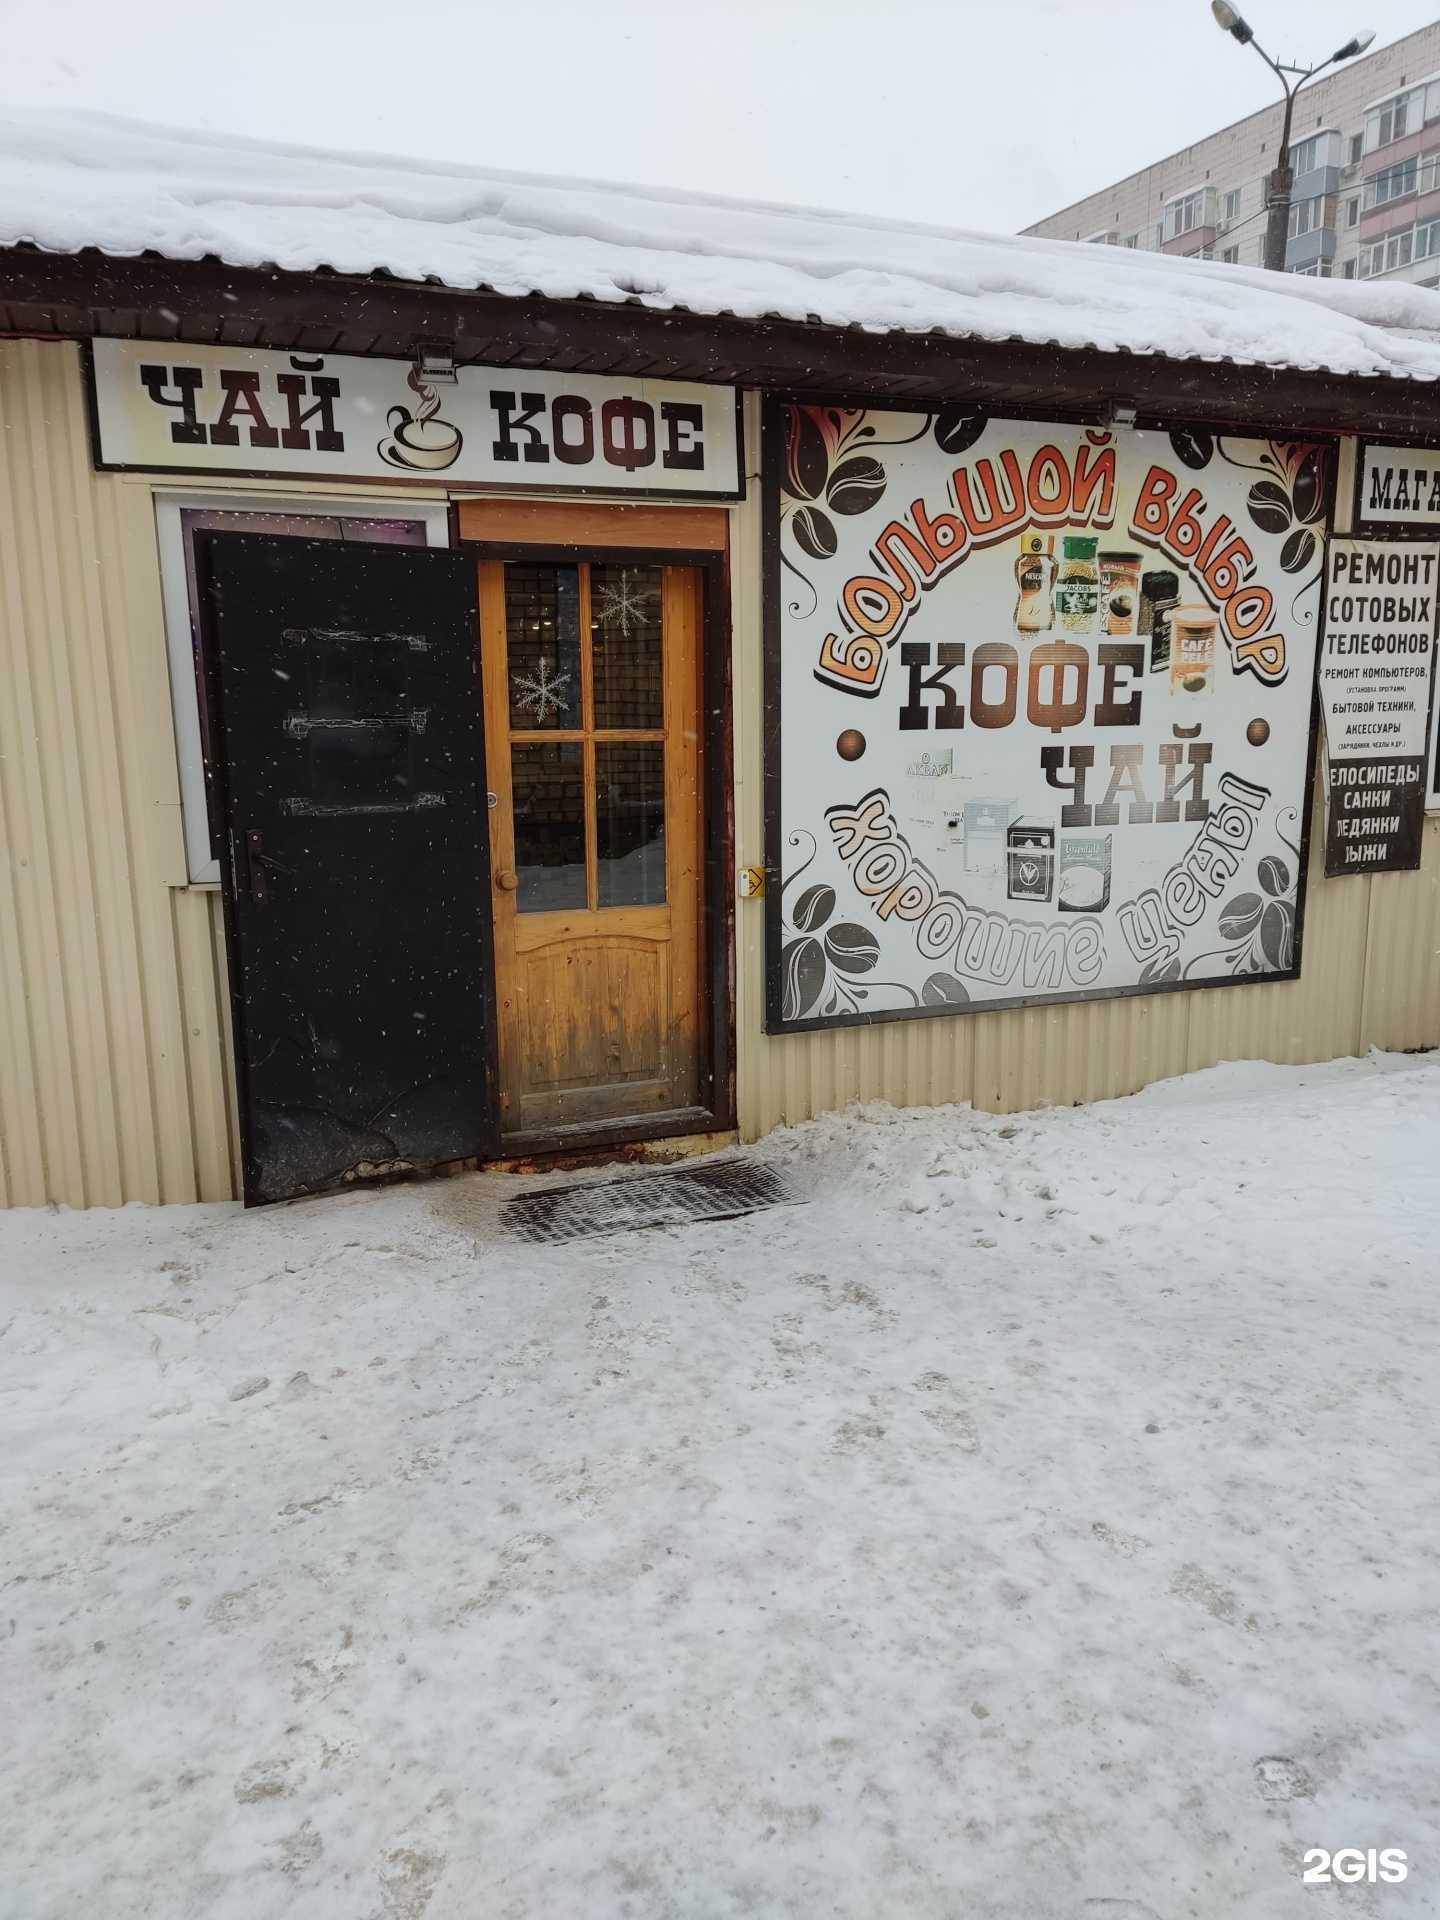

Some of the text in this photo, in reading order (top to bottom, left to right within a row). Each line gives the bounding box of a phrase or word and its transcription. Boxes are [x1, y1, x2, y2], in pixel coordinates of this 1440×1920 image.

[140, 356, 705, 472] ЧАЙ КОФЕ
[814, 429, 1289, 697] БОЛЬШОЙ ВЫБОР
[1332, 552, 1436, 585] РЕМОНТ
[1066, 584, 1092, 592] JACOBS
[1330, 596, 1431, 623] СОТОВЫХ
[1327, 633, 1429, 655] ТЕЛЕФОНОВ
[1325, 668, 1360, 679] РЕМОНТ
[899, 639, 1145, 734] КОФЕ
[1332, 701, 1375, 713] БЫТОВОЙ
[1345, 722, 1401, 735] АКСЕССУАРЫ
[1041, 723, 1213, 828] ЧАЙ
[1343, 789, 1392, 810] САНКИ
[1337, 816, 1400, 839] ЛЕДЯНКИ
